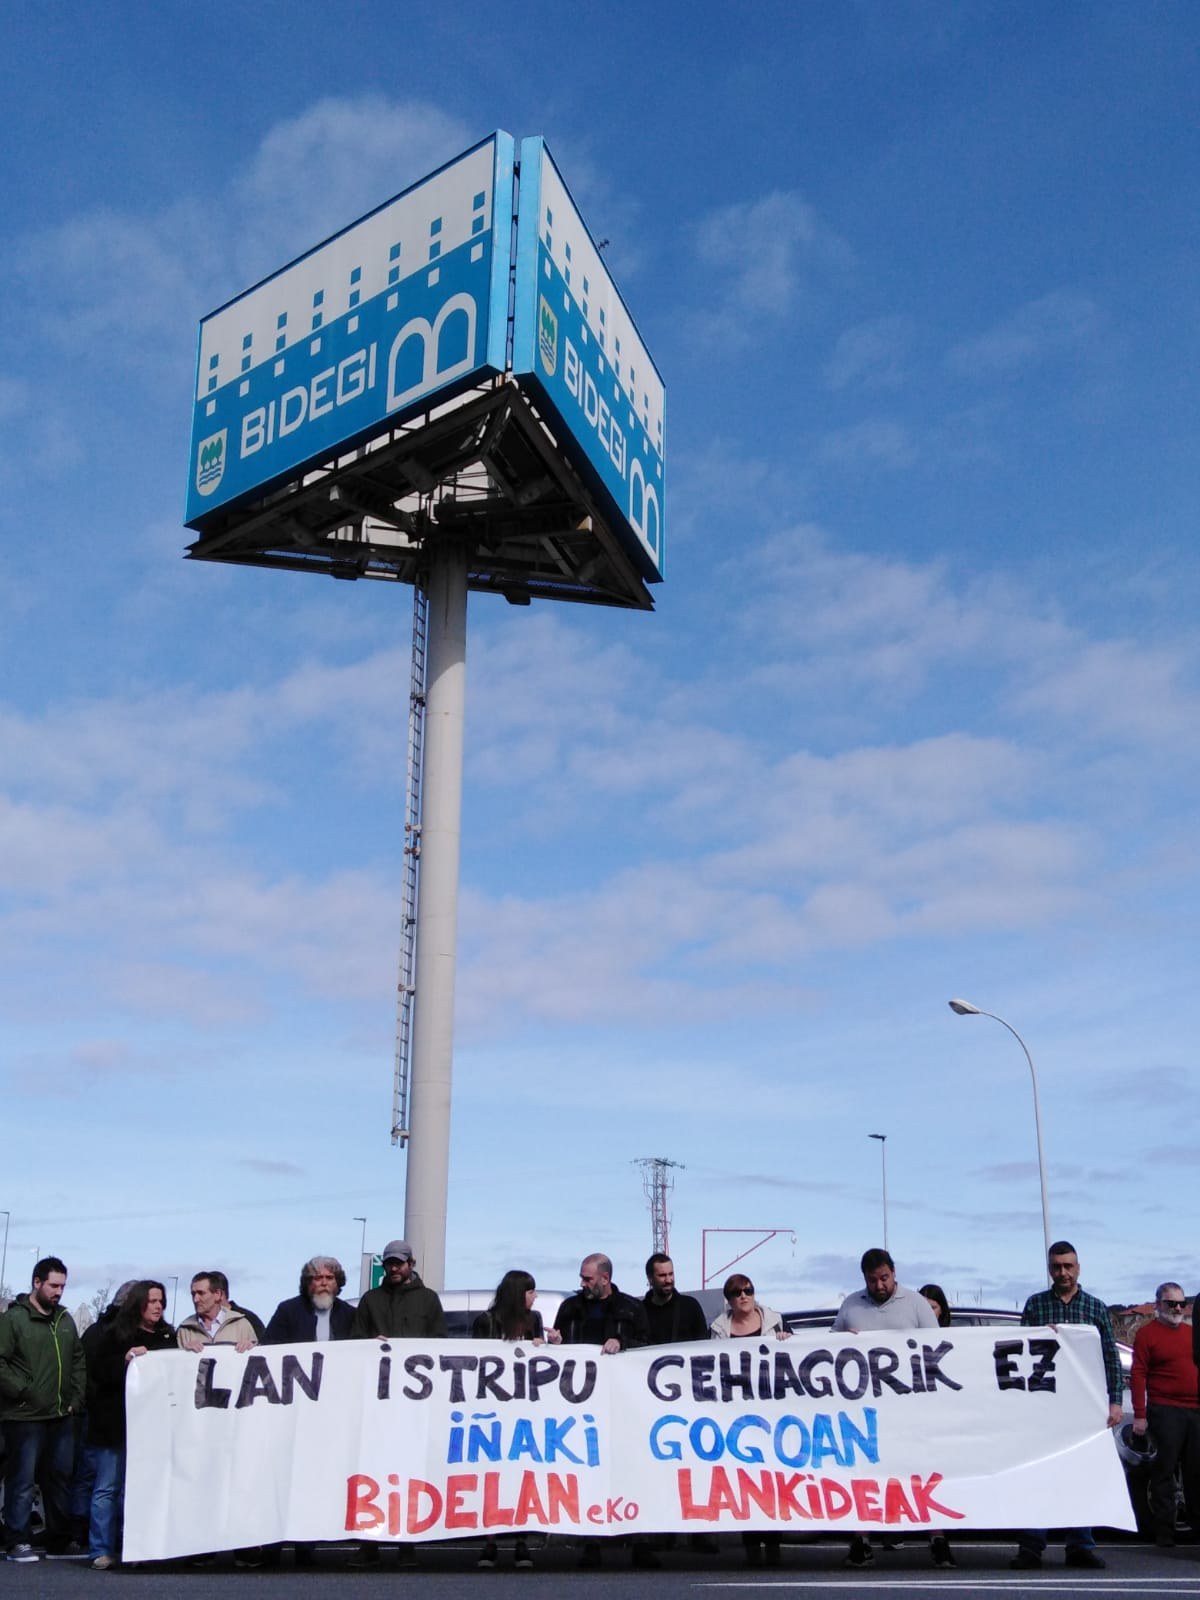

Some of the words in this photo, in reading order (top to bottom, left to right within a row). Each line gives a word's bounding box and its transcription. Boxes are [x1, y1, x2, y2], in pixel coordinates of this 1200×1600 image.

[240, 342, 377, 459] BIDEGI
[564, 336, 627, 480] BIDEGI
[194, 1352, 324, 1409] LAN
[993, 1339, 1061, 1394] EZ
[649, 1407, 880, 1469] GOGOAN
